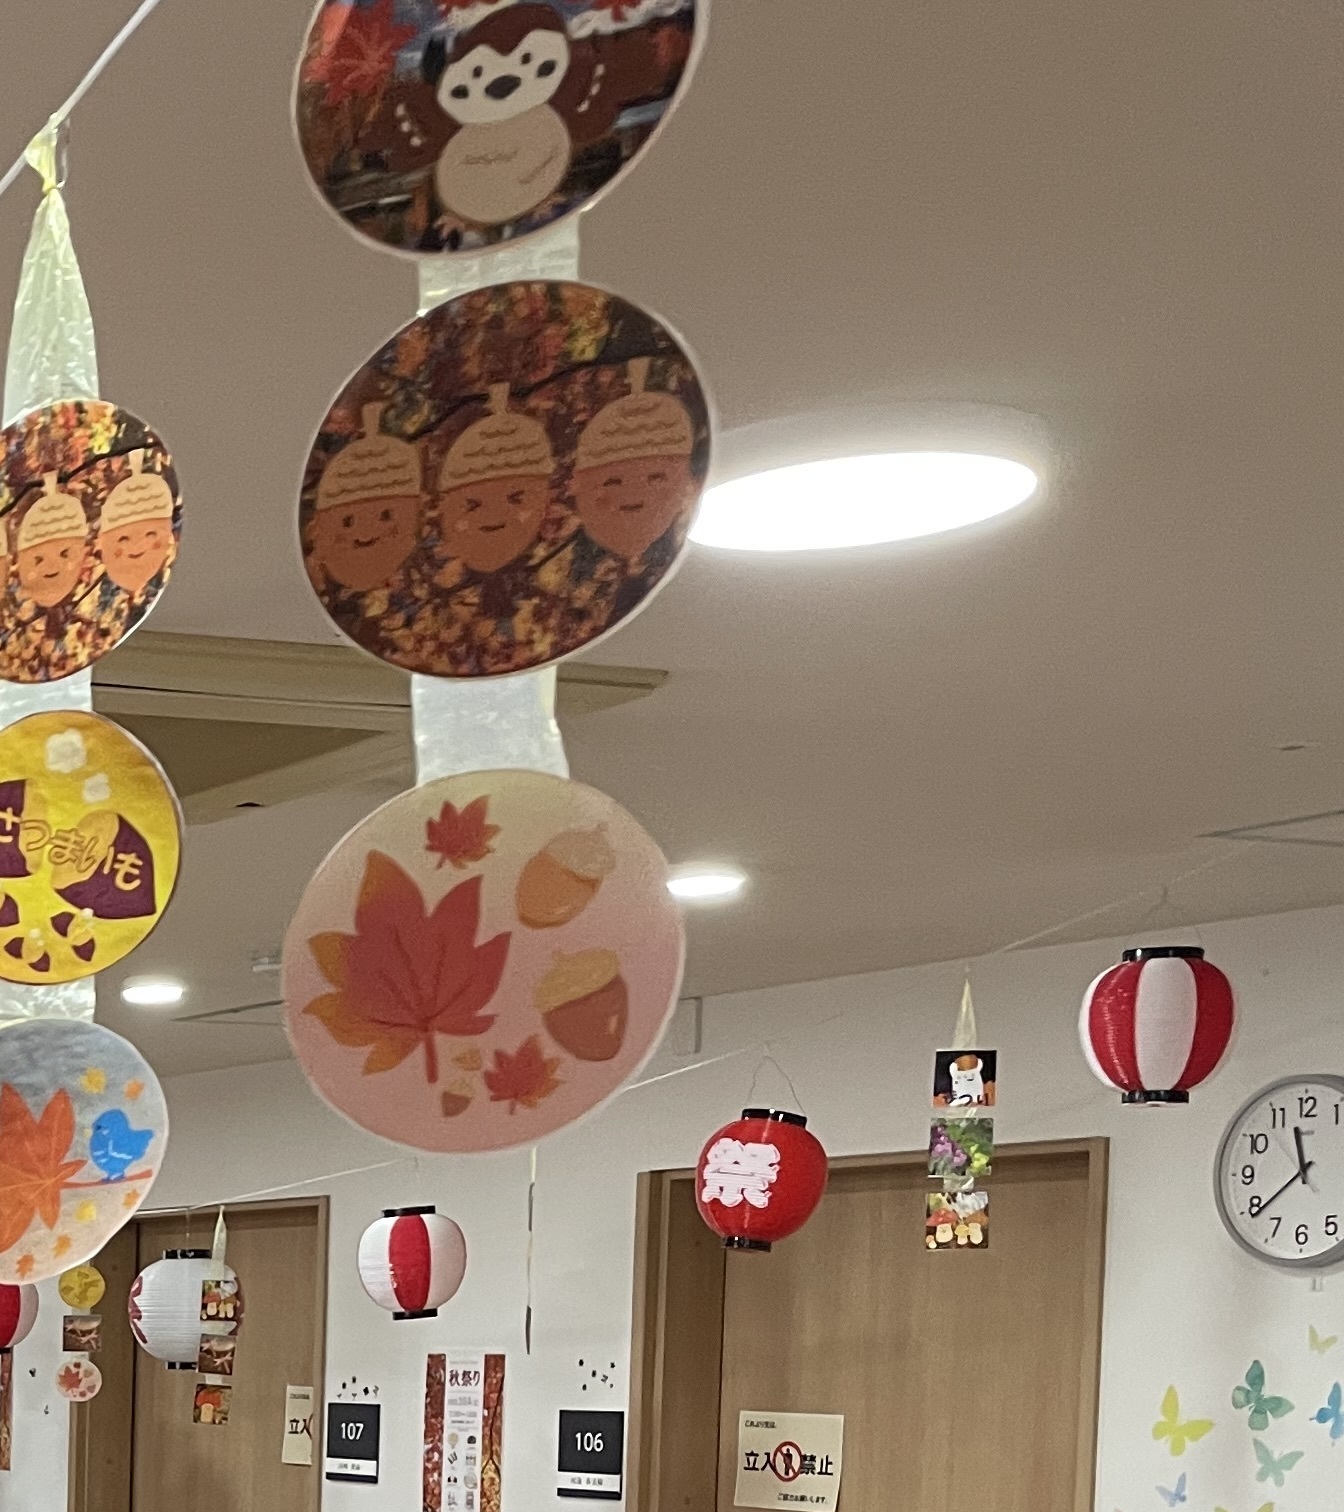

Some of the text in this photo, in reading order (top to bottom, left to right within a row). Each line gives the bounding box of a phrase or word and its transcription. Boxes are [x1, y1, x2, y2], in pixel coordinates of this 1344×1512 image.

[1271, 1107, 1286, 1129] 11
[1298, 1096, 1318, 1118] 12
[1333, 1103, 1340, 1125] 1
[1249, 1133, 1269, 1155] 10
[702, 1137, 781, 1209] 祭
[1241, 1164, 1255, 1185] 9
[1248, 1195, 1262, 1218] 8
[1269, 1216, 1282, 1238] 7
[1295, 1224, 1309, 1245] 6
[1325, 1214, 1339, 1236] 5
[449, 1370, 481, 1387] 秋祭り
[340, 1422, 365, 1440] 107
[575, 1432, 604, 1452] 106
